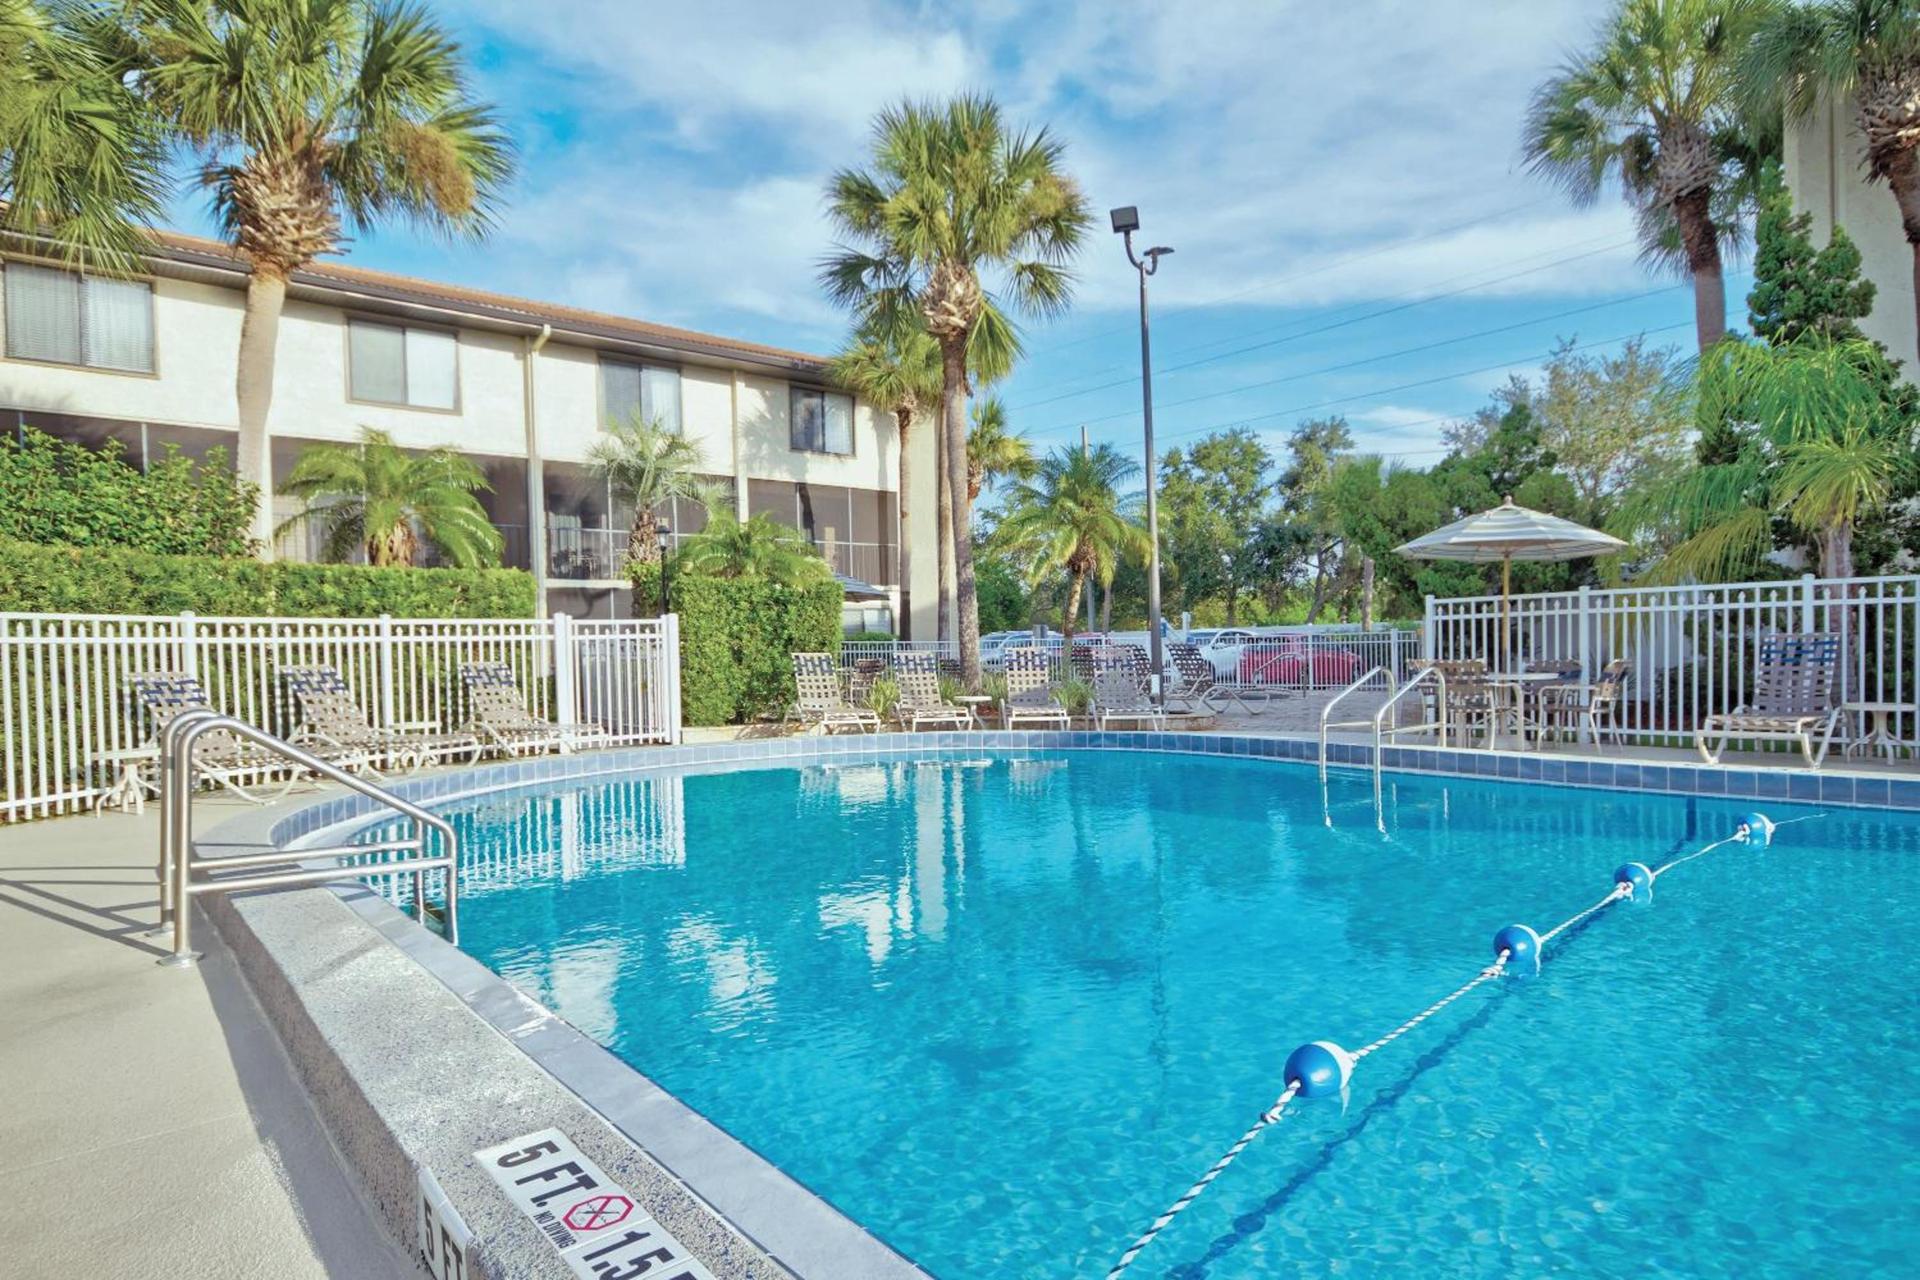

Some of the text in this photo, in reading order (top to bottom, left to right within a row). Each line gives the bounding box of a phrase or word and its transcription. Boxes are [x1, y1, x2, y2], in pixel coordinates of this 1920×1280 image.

[497, 1140, 599, 1207] 5 FT.
[423, 1195, 435, 1261] 5
[533, 1210, 577, 1249] NO DIVING
